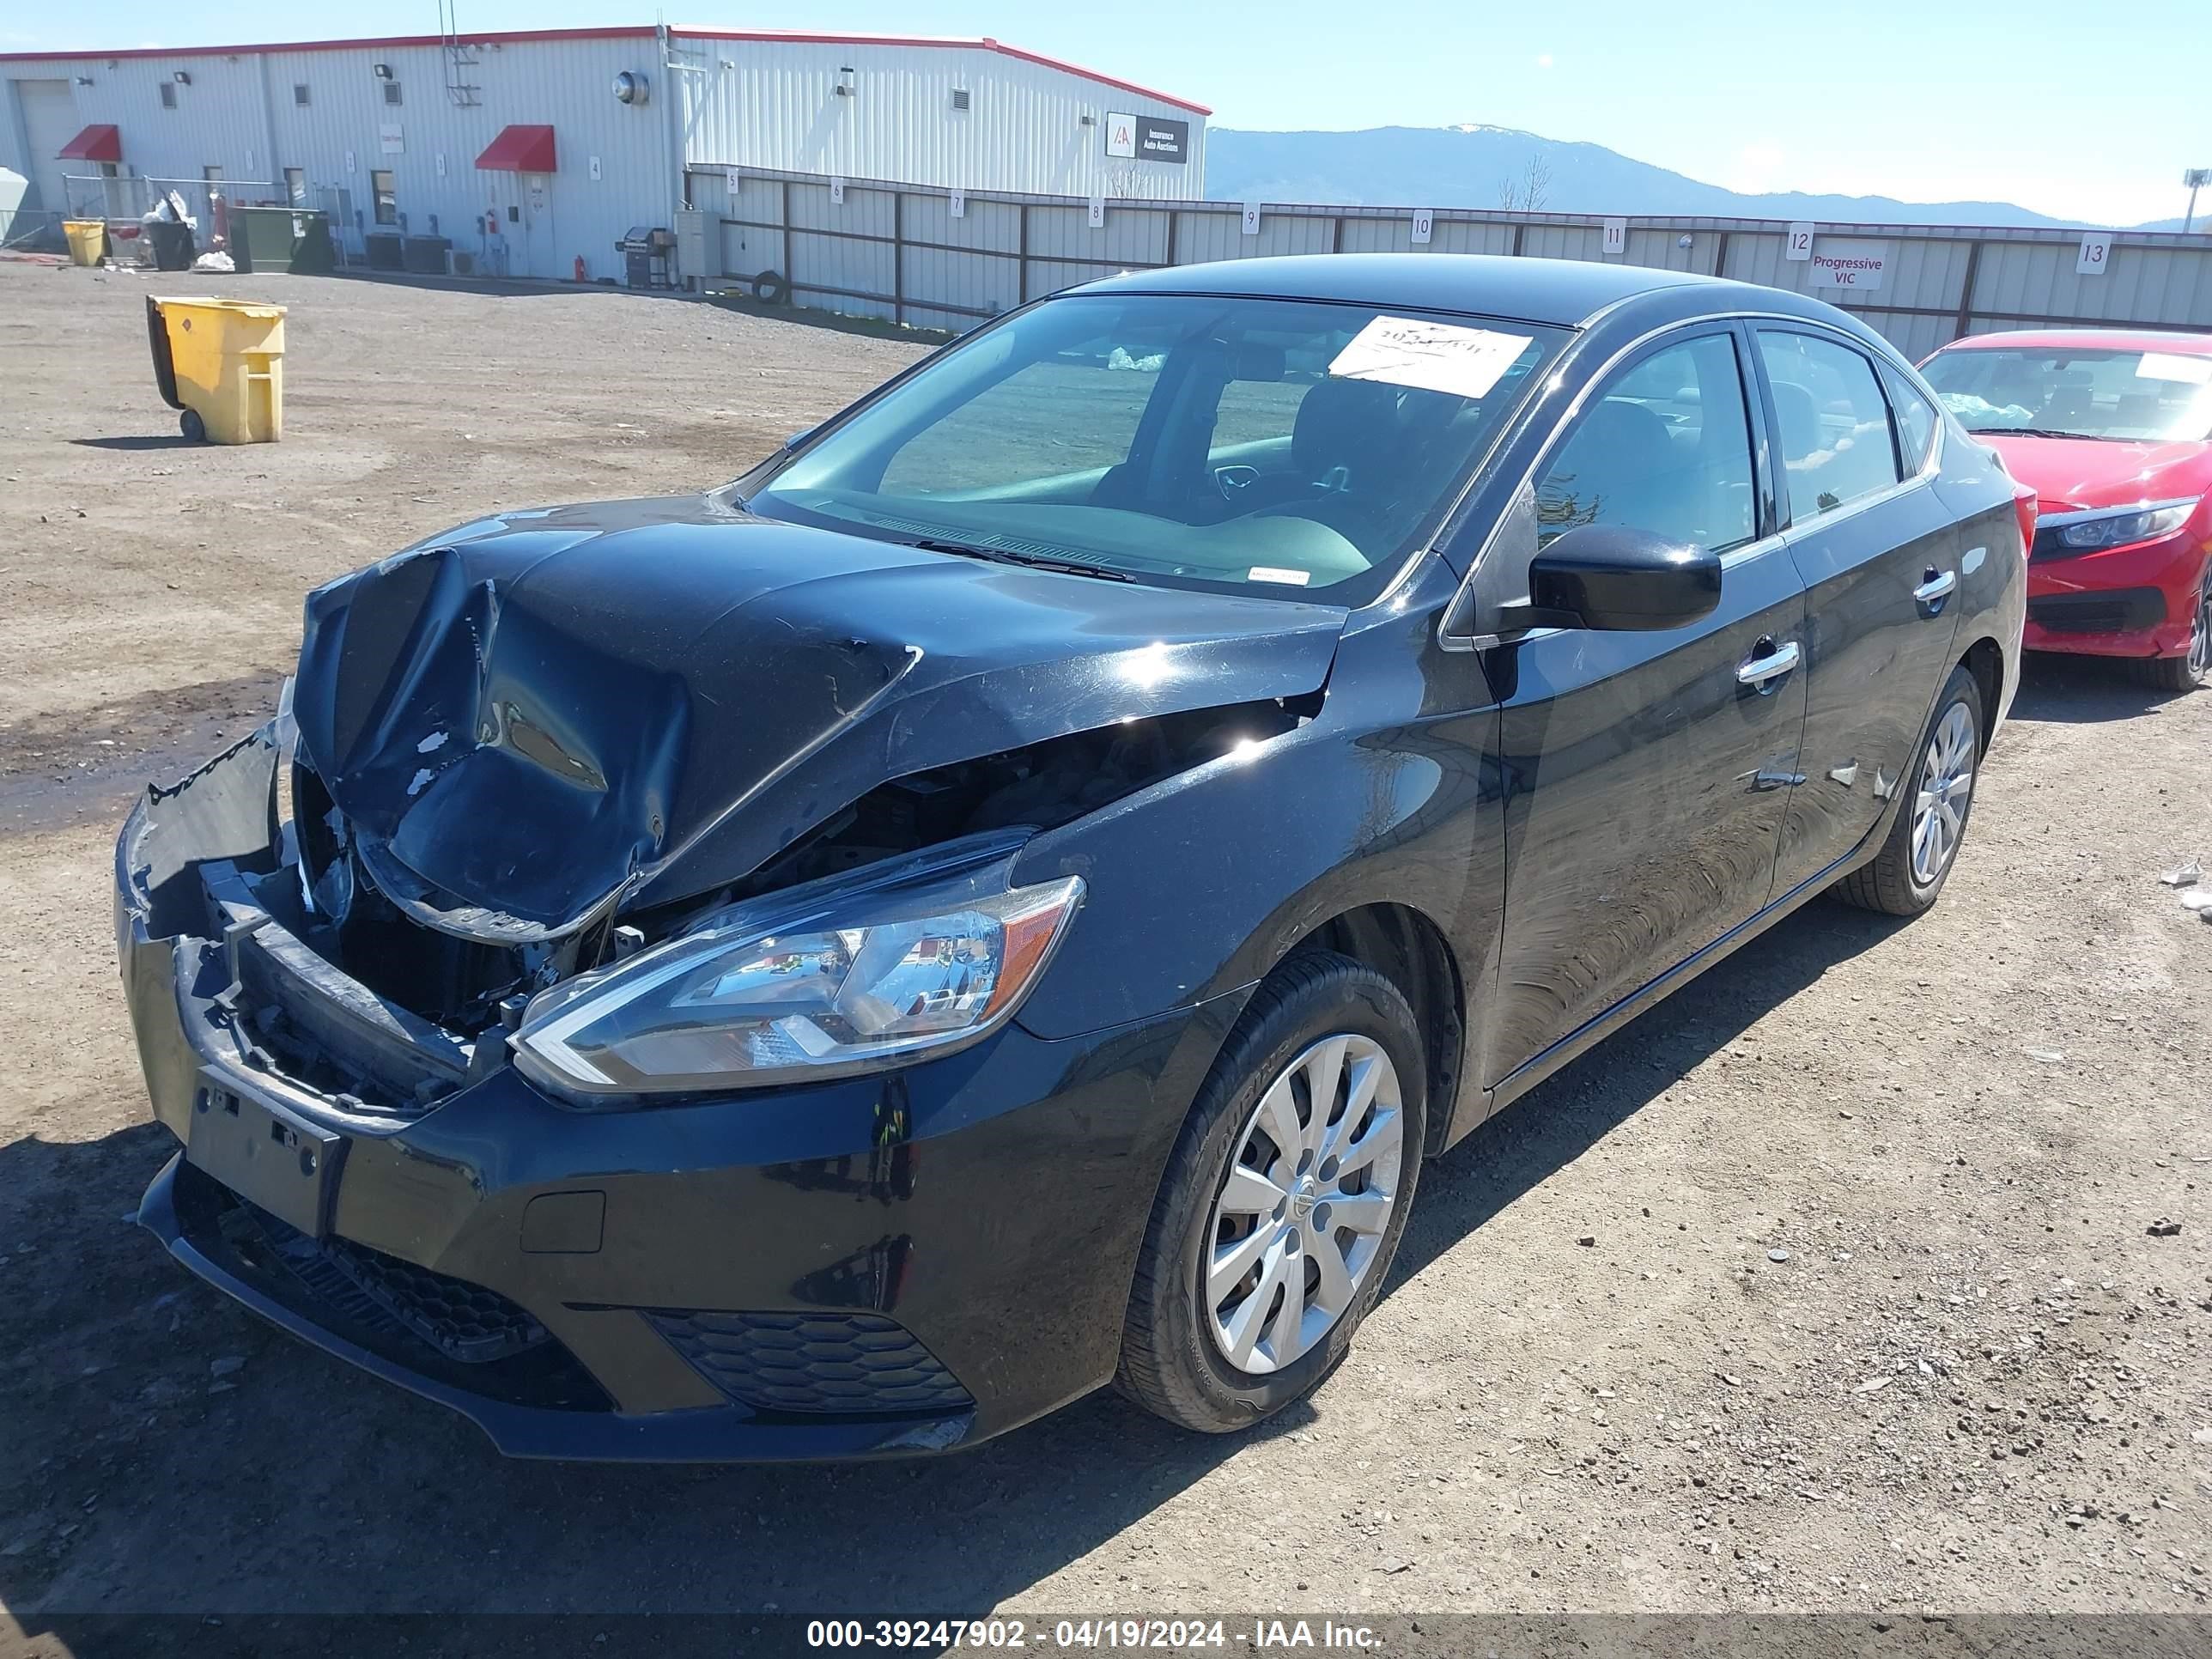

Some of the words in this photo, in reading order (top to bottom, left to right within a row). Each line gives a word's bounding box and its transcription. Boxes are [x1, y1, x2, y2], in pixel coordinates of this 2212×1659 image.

[1149, 128, 1175, 141] Insurance
[1144, 139, 1157, 150] Auto
[1157, 140, 1179, 153] Auctions
[592, 162, 599, 173] 4
[729, 175, 735, 185] 5
[834, 185, 841, 197] 6
[954, 197, 961, 209] 7
[1092, 205, 1099, 219] 8
[1247, 211, 1255, 225] 9
[1415, 219, 1429, 234] 10
[1607, 228, 1620, 244] 11
[1791, 233, 1808, 250] 12
[2083, 242, 2103, 259] 13
[1814, 256, 1882, 270] Progressive
[1835, 272, 1856, 284] VIC
